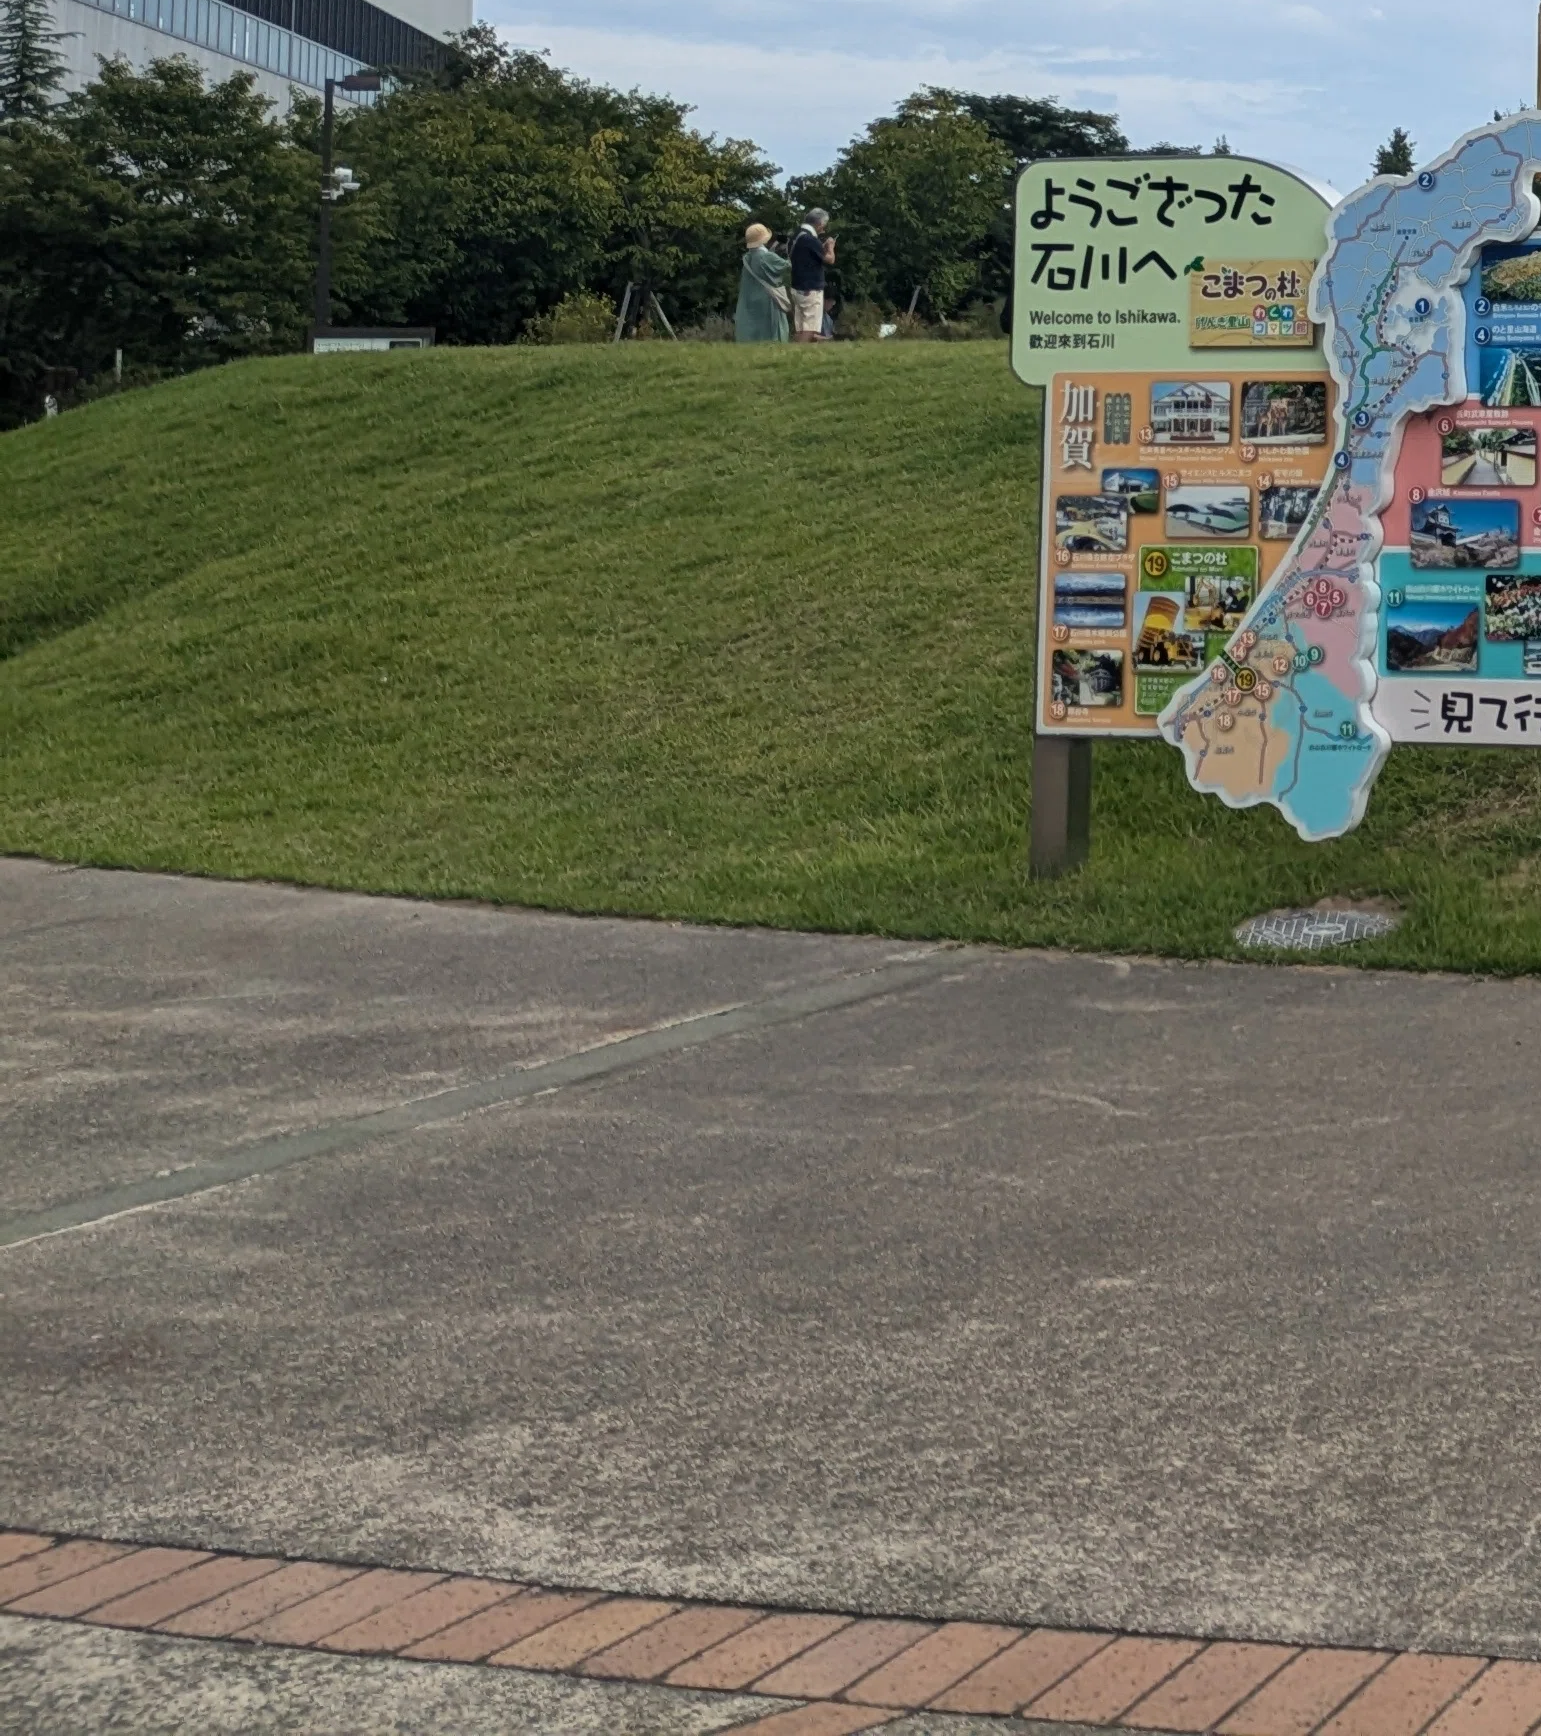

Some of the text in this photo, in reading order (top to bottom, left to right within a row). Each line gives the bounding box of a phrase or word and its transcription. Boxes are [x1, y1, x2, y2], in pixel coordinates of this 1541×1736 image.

[1421, 174, 1430, 186] 2
[1030, 242, 1178, 291] 石川へ
[1201, 270, 1301, 301] こまつの杜
[1477, 299, 1486, 312] 2
[1029, 309, 1181, 325] Welcome to Ishikawa.
[1254, 322, 1307, 335] コマツ館
[1477, 328, 1486, 341] 4
[1029, 333, 1115, 349] 歡迎來到石川
[1059, 379, 1097, 470] 加賀
[1358, 413, 1367, 425] 3
[1441, 419, 1449, 431] 6
[1140, 429, 1152, 441] 13
[1242, 446, 1254, 459] 12
[1337, 454, 1347, 465] 4
[1164, 477, 1177, 488] 15
[1257, 475, 1270, 487] 14
[1412, 488, 1420, 501] 8
[1056, 549, 1068, 562] 16
[1170, 552, 1228, 566] こまつの杜
[1147, 555, 1165, 573] 19
[1319, 581, 1327, 593] 8
[1306, 594, 1314, 605] 6
[1332, 592, 1341, 603] 5
[1389, 591, 1400, 604] 11
[1320, 603, 1328, 615] 7
[1055, 627, 1067, 638] 17
[1242, 632, 1254, 643] 13
[1232, 646, 1244, 657] 14
[1310, 650, 1318, 660] 9
[1274, 660, 1286, 671] 12
[1294, 656, 1306, 666] 10
[1212, 668, 1224, 679] 16
[1239, 673, 1253, 686] 19
[1226, 691, 1239, 702] 17
[1256, 685, 1269, 696] 15
[1051, 704, 1064, 715] 18
[1219, 716, 1231, 727] 18
[1342, 724, 1352, 735] 11
